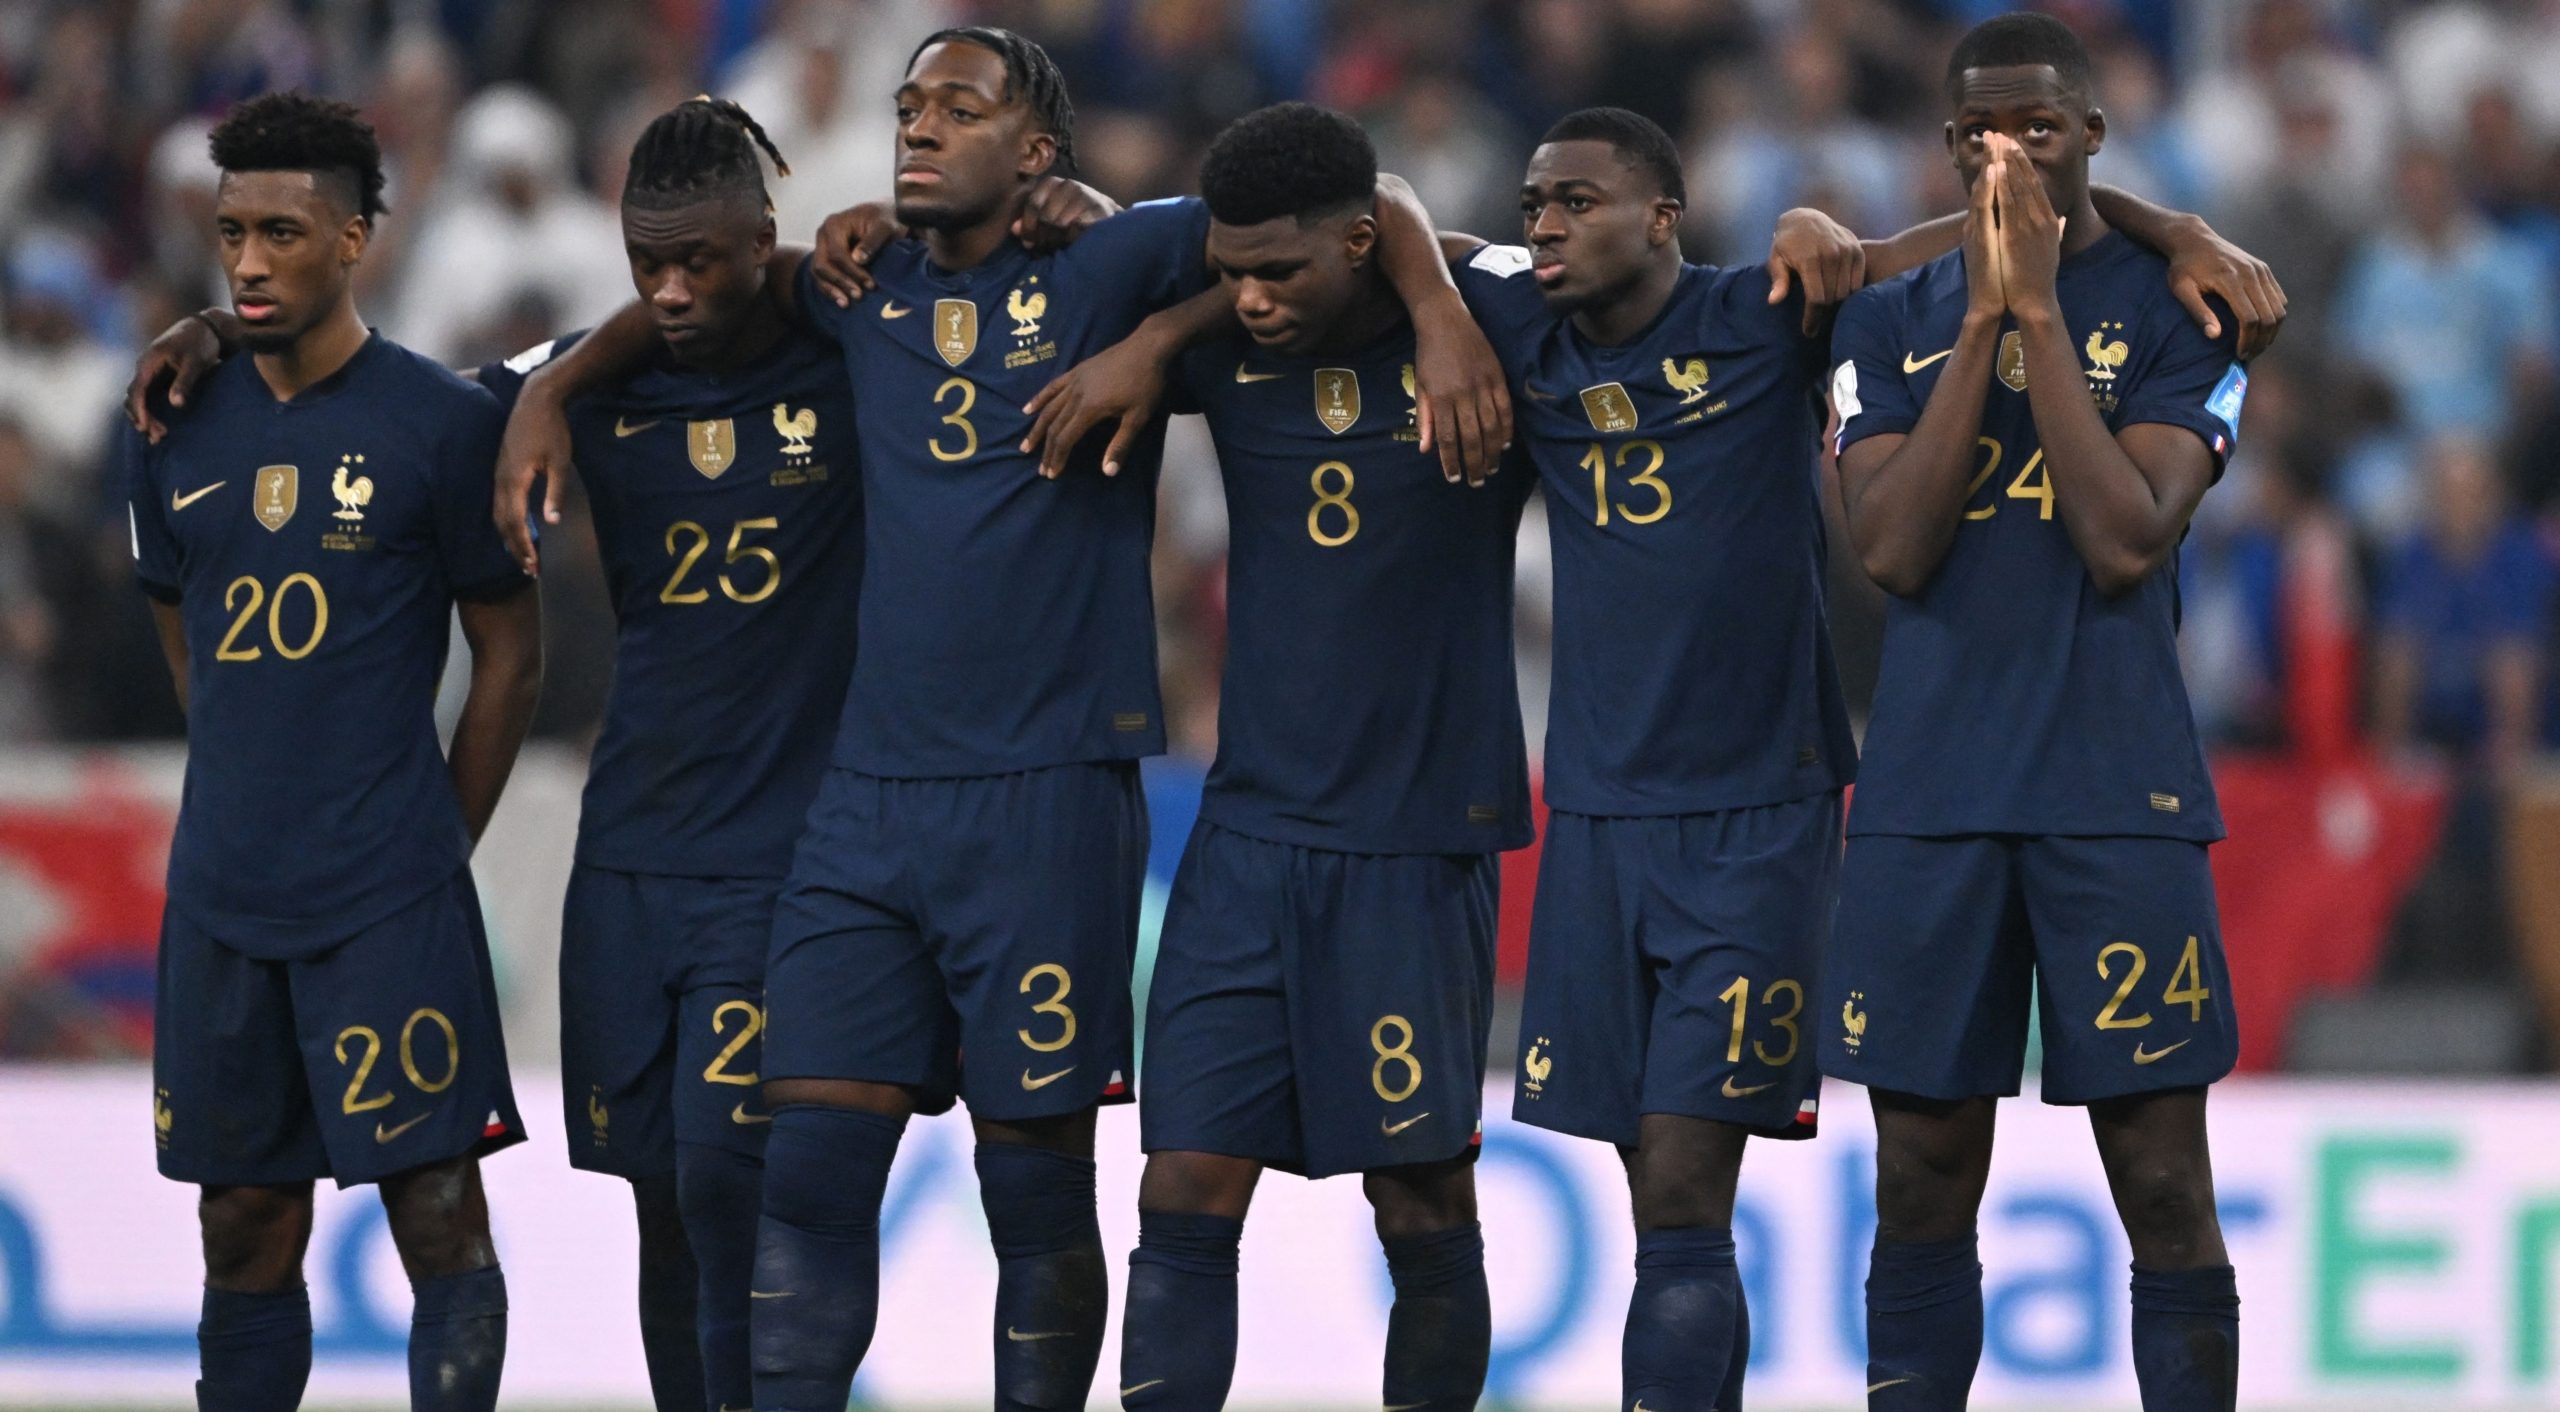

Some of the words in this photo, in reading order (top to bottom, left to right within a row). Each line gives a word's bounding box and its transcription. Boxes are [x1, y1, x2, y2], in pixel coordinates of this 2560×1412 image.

[1329, 408, 1348, 417] FIFA
[2010, 368, 2026, 376] FIF
[929, 377, 978, 462] 3
[1606, 418, 1626, 429] FIFA
[1307, 460, 1360, 547] 8
[1580, 444, 1673, 526] 13
[1963, 436, 2056, 521] 24
[660, 516, 780, 604] 25
[215, 572, 329, 662] 20
[1018, 963, 1077, 1052] 3
[1719, 975, 1803, 1066] 13
[2094, 936, 2209, 1030] 24
[335, 1007, 459, 1115] 20
[703, 1000, 761, 1086] 2
[1371, 1014, 1423, 1103] 8
